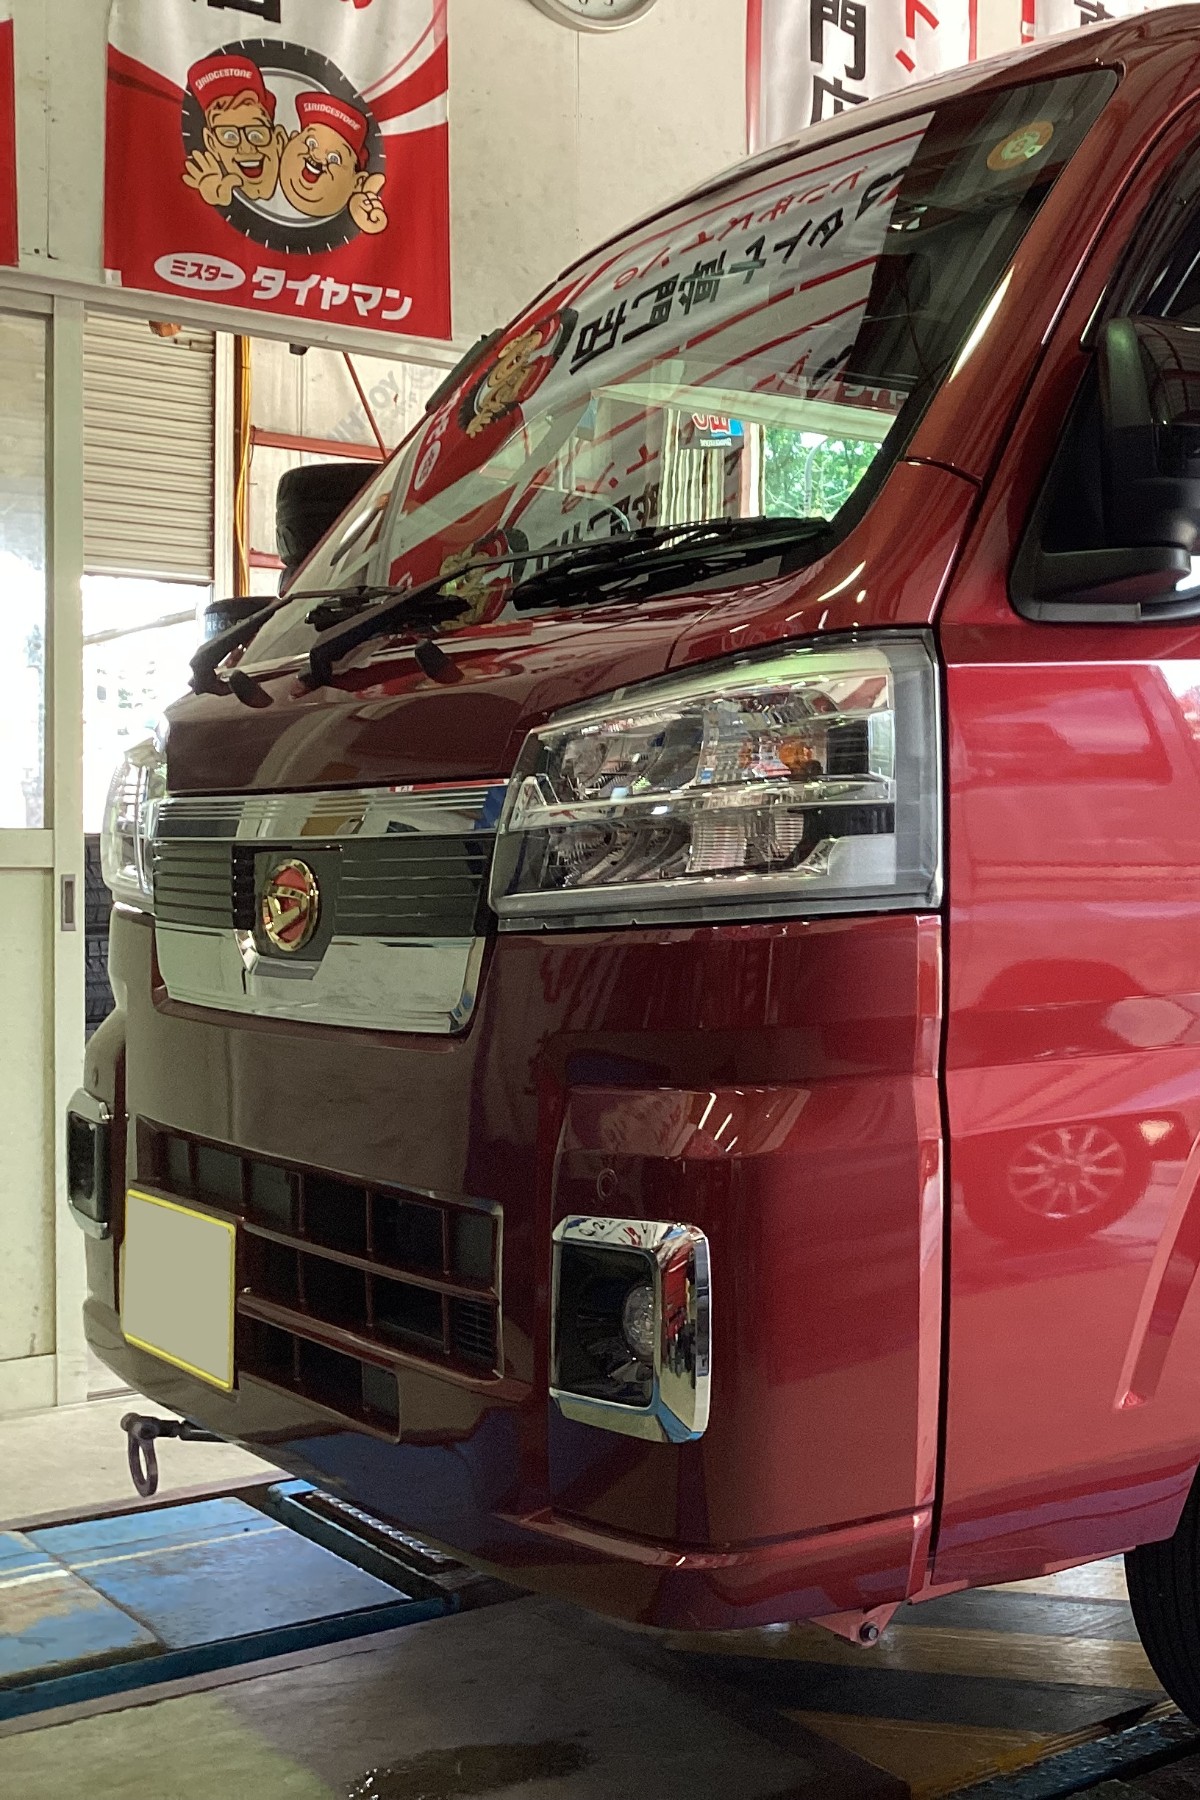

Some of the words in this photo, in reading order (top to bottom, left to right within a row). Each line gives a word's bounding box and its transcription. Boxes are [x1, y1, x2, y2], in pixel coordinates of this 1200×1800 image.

[194, 68, 253, 90] BRIDGESTONE
[303, 102, 361, 131] BRIDGESTONE
[170, 259, 235, 282] ミスター
[252, 265, 413, 321] タイヤマン
